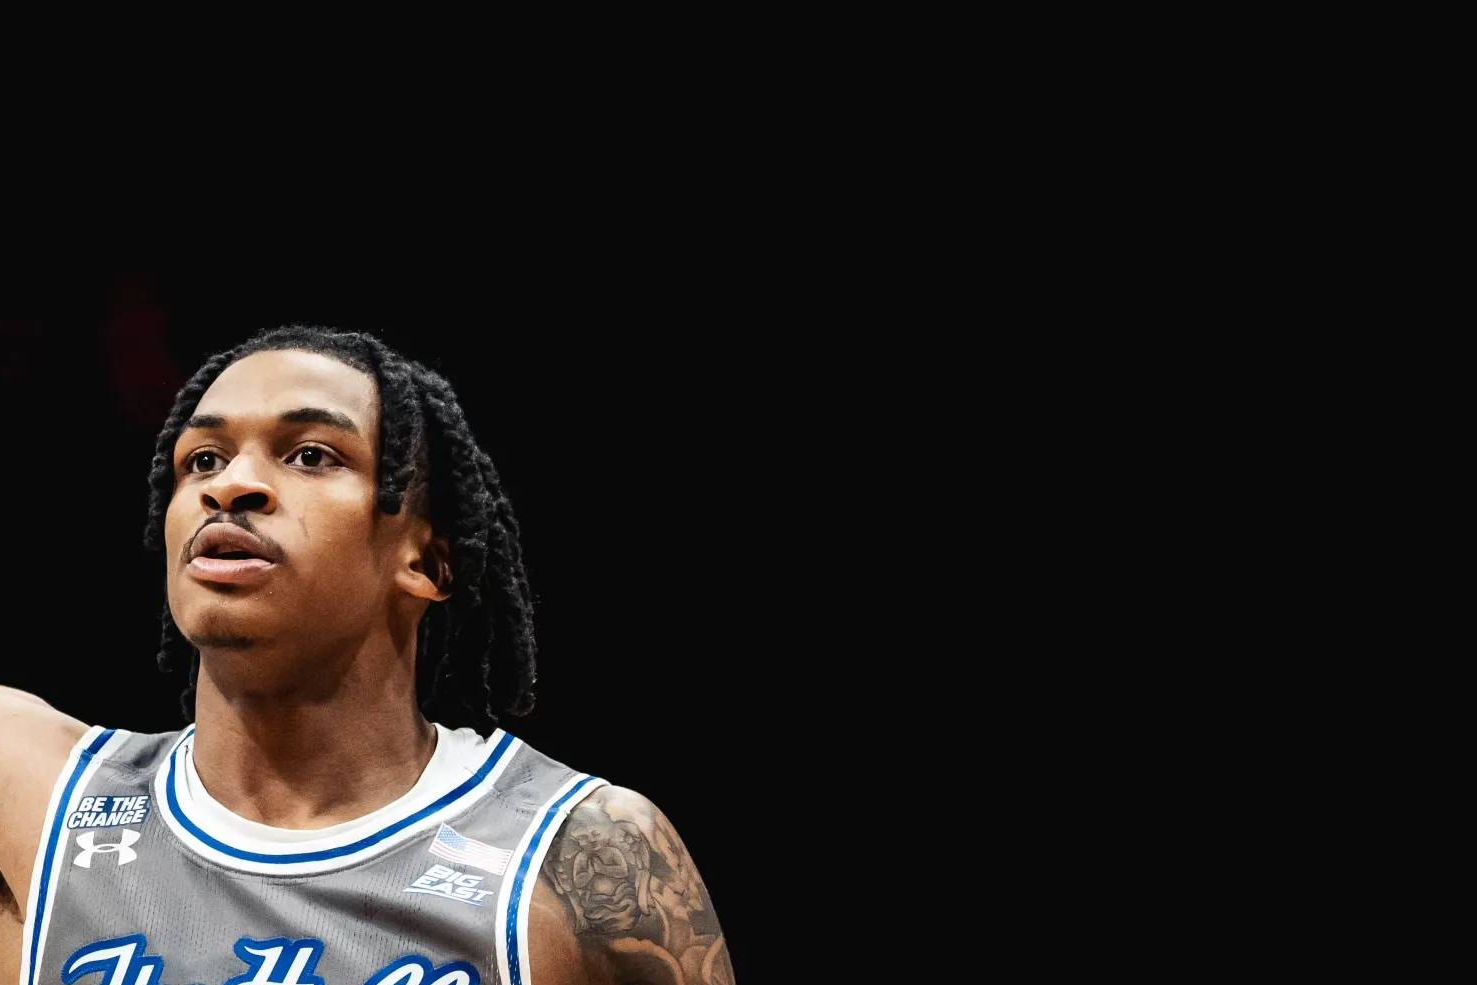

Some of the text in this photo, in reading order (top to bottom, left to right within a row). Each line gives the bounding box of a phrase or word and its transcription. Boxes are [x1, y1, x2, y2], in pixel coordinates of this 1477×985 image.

[78, 795, 149, 812] BE THE
[67, 808, 147, 829] CHANGE
[424, 863, 484, 888] BIG
[410, 874, 494, 902] EAST
